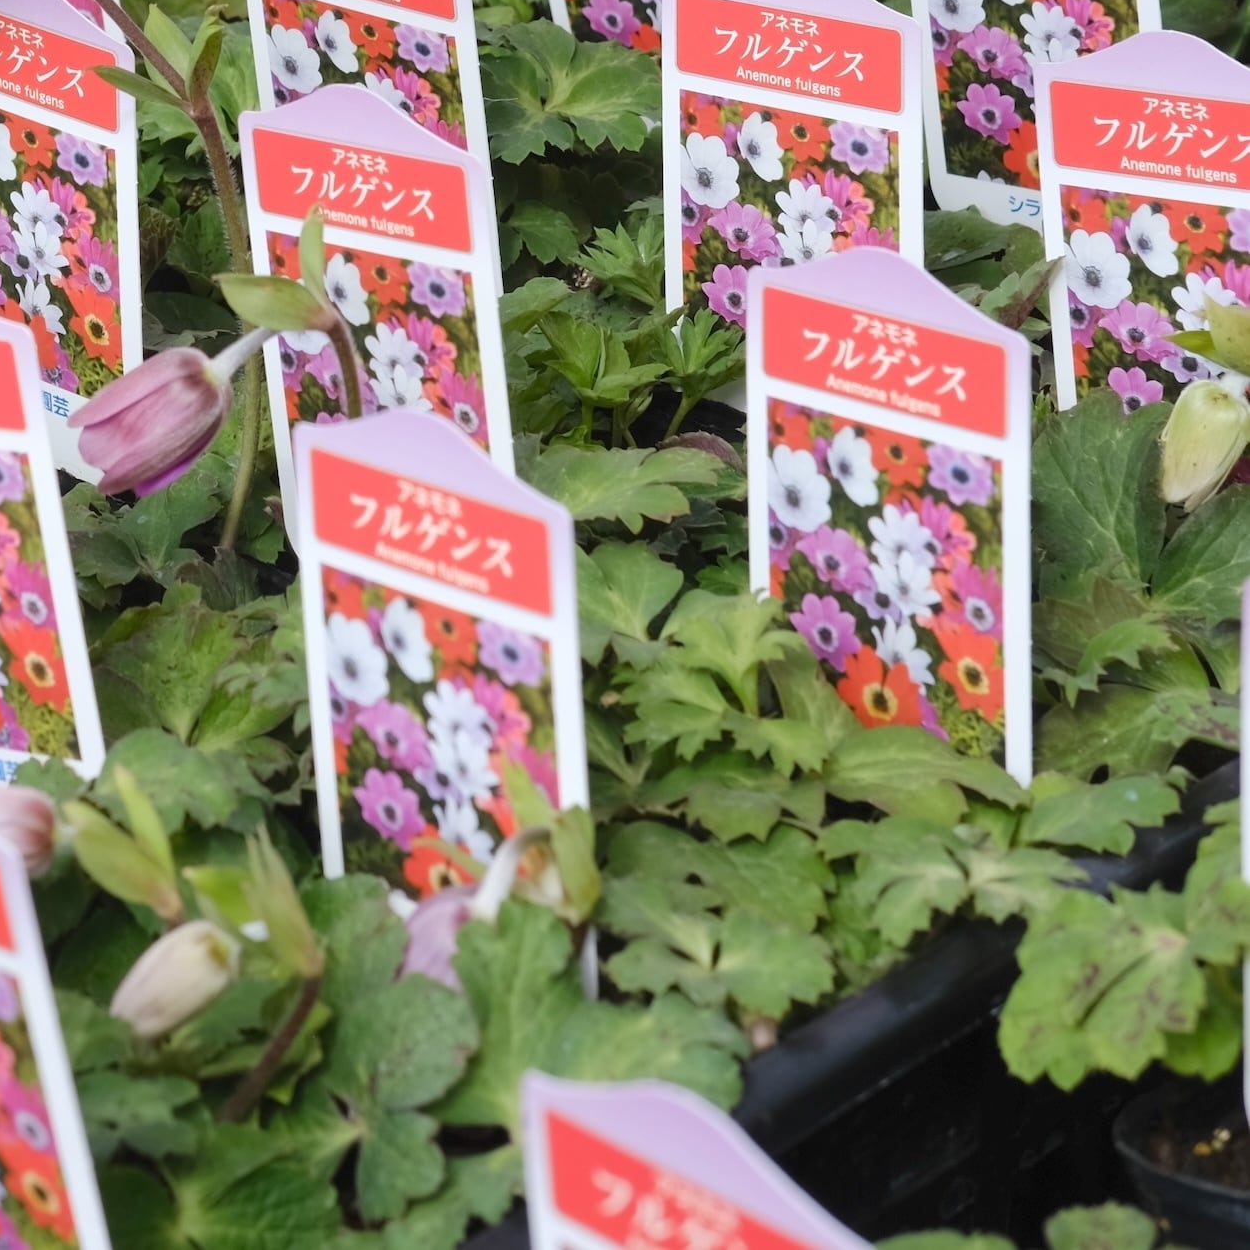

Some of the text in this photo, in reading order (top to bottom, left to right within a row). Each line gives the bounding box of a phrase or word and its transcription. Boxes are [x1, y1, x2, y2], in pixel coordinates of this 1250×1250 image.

[760, 11, 820, 38] アネモネ
[714, 26, 864, 82] フルゲンス
[24, 84, 65, 110] fulgens
[735, 65, 841, 98] Anemone fulgens
[1142, 96, 1209, 122] アネモネ
[331, 147, 389, 175] アネモネ
[1119, 155, 1238, 184] Anemone fulgens
[290, 164, 435, 221] フルゲンス
[370, 215, 415, 238] fulgens
[852, 314, 917, 348] アネモネ
[803, 328, 966, 401] フルゲンス
[826, 373, 941, 417] Anemone fulgens
[350, 494, 512, 576] フルゲンス
